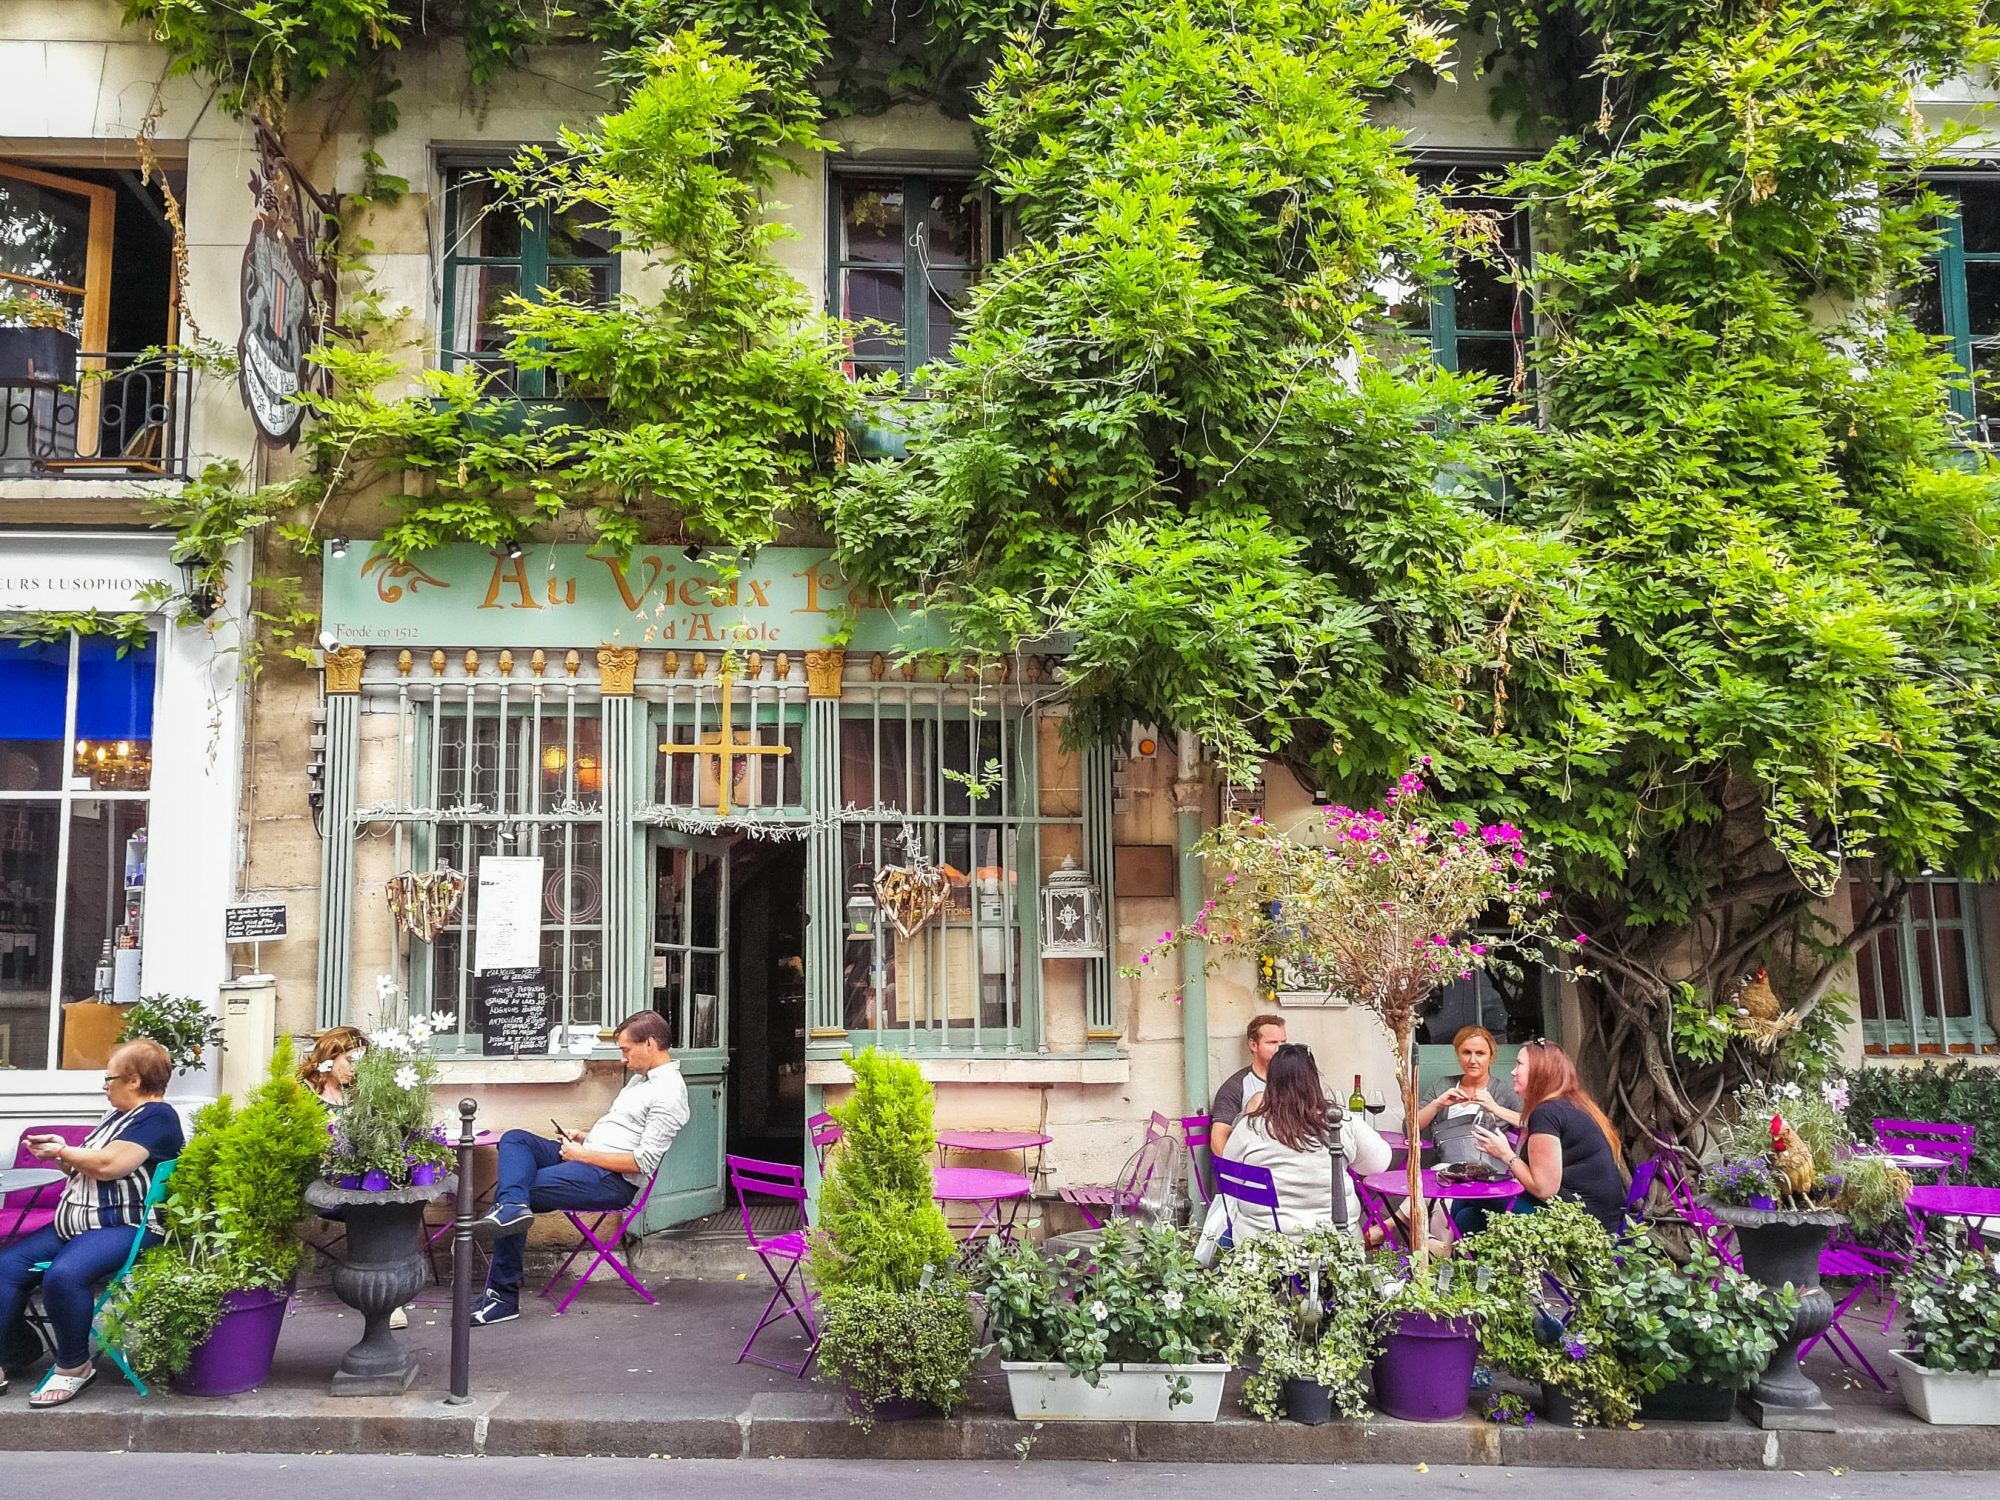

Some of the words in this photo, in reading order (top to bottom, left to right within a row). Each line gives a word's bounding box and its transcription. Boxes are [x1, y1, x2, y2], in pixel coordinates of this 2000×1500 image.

[477, 550, 577, 611] Au
[586, 554, 772, 612] Vieux
[334, 623, 372, 640] Fondé
[377, 628, 391, 643] en
[394, 627, 419, 640] 1512
[945, 907, 972, 916] TIONS
